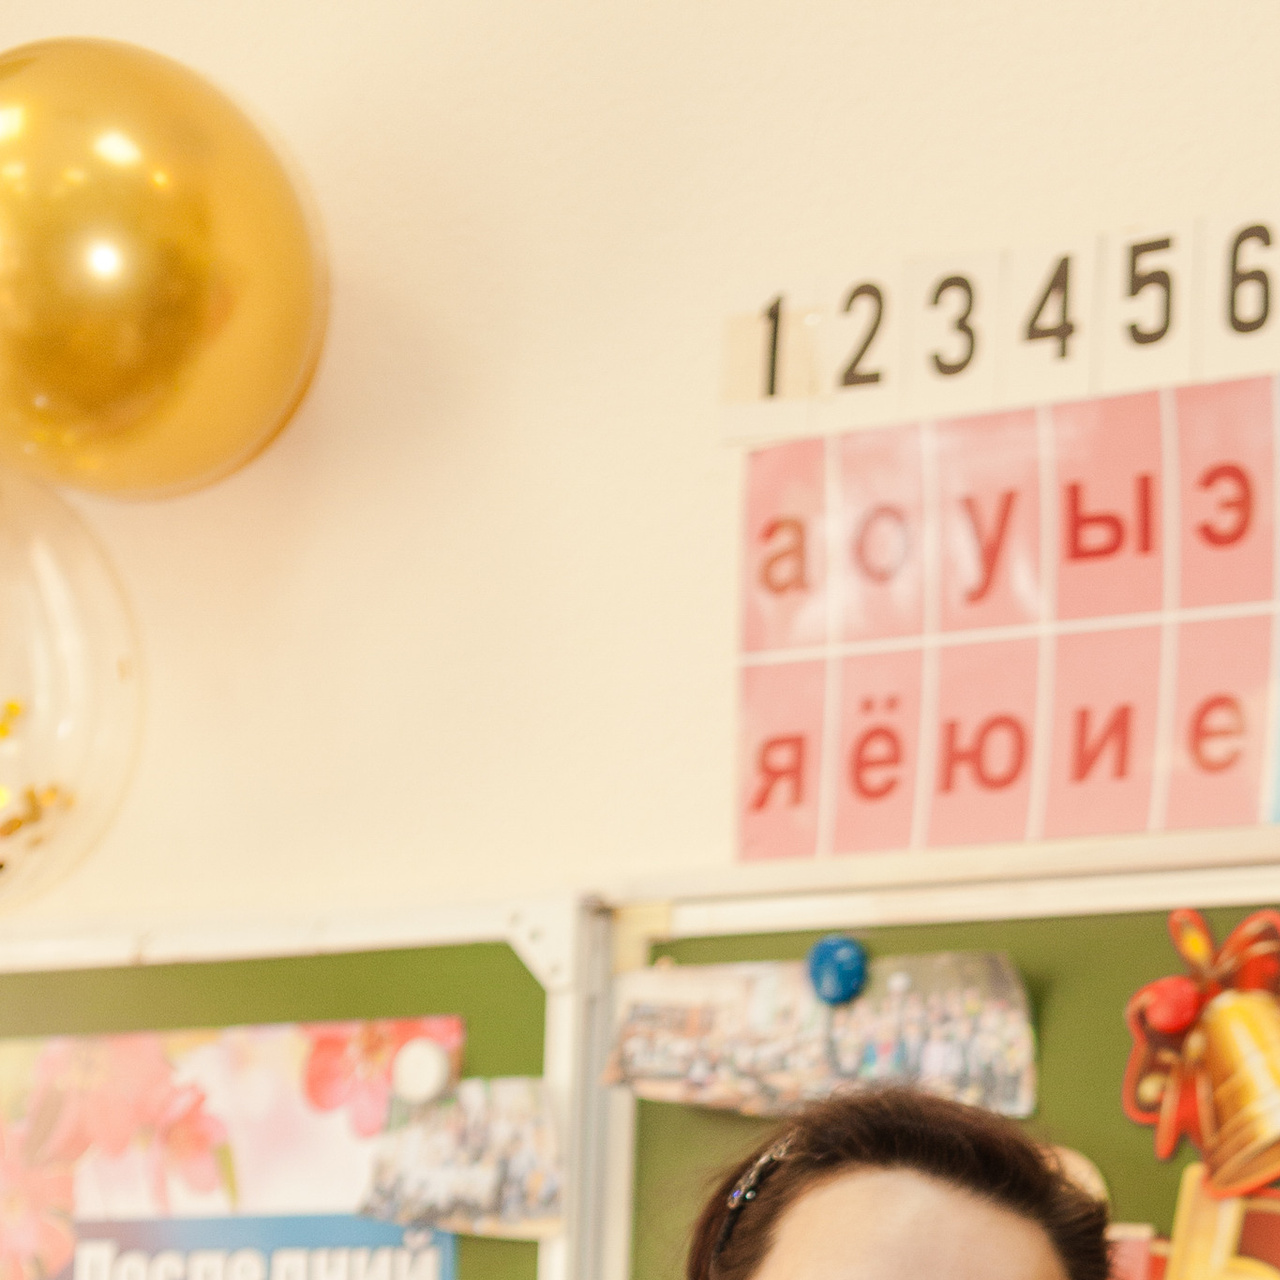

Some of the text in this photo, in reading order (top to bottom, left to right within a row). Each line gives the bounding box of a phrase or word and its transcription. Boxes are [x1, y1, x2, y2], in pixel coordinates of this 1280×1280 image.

[764, 297, 783, 397] 1
[839, 282, 885, 388] 2
[930, 274, 977, 377] 3
[1024, 256, 1076, 360] 4
[1125, 236, 1174, 346] 5
[1225, 223, 1274, 335] 6
[757, 515, 811, 595] а
[960, 488, 1018, 606] у
[1065, 474, 1153, 563] ы
[1198, 462, 1255, 547] э
[750, 732, 808, 812] я
[849, 693, 904, 801] ё
[939, 712, 1027, 794] ю
[1071, 704, 1132, 782] и
[1188, 690, 1247, 774] е
